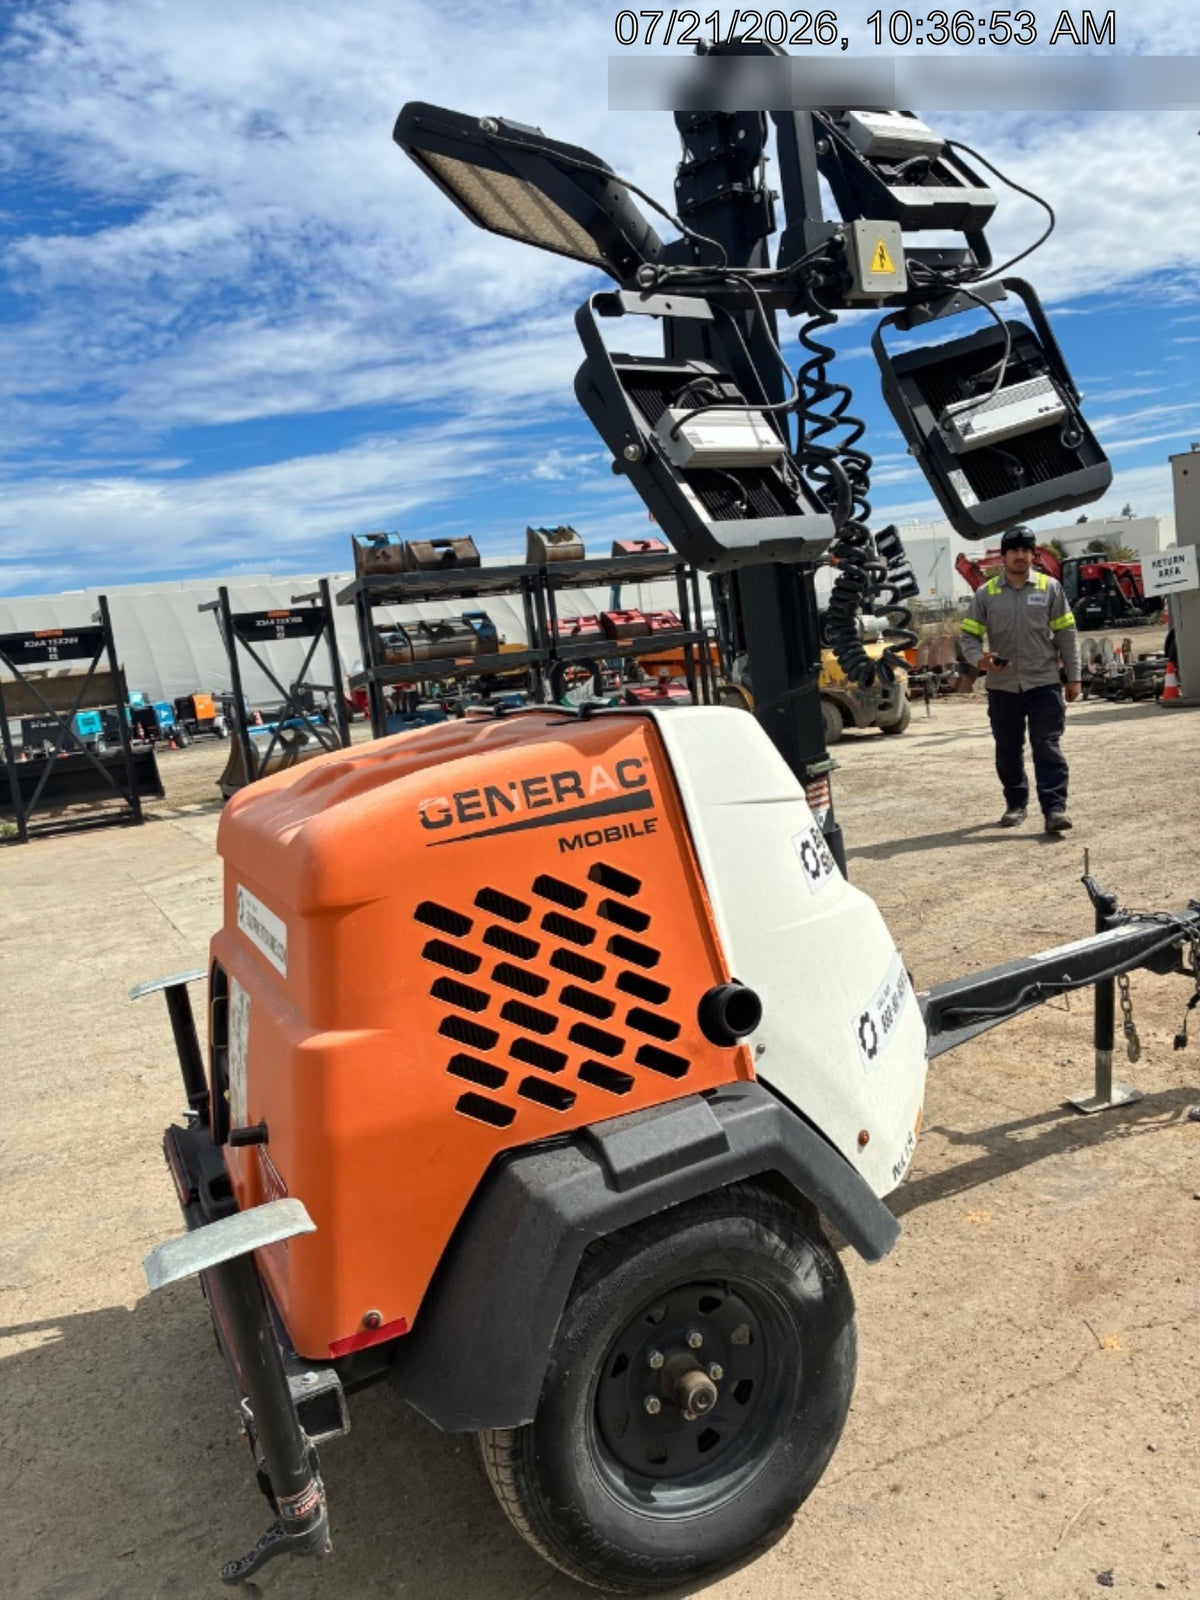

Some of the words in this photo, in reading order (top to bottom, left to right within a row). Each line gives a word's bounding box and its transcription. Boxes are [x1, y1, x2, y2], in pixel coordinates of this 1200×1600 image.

[1151, 554, 1185, 569] RETURN
[1158, 567, 1182, 578] AREA
[417, 758, 648, 829] GENERAC
[557, 818, 659, 853] MOBILE
